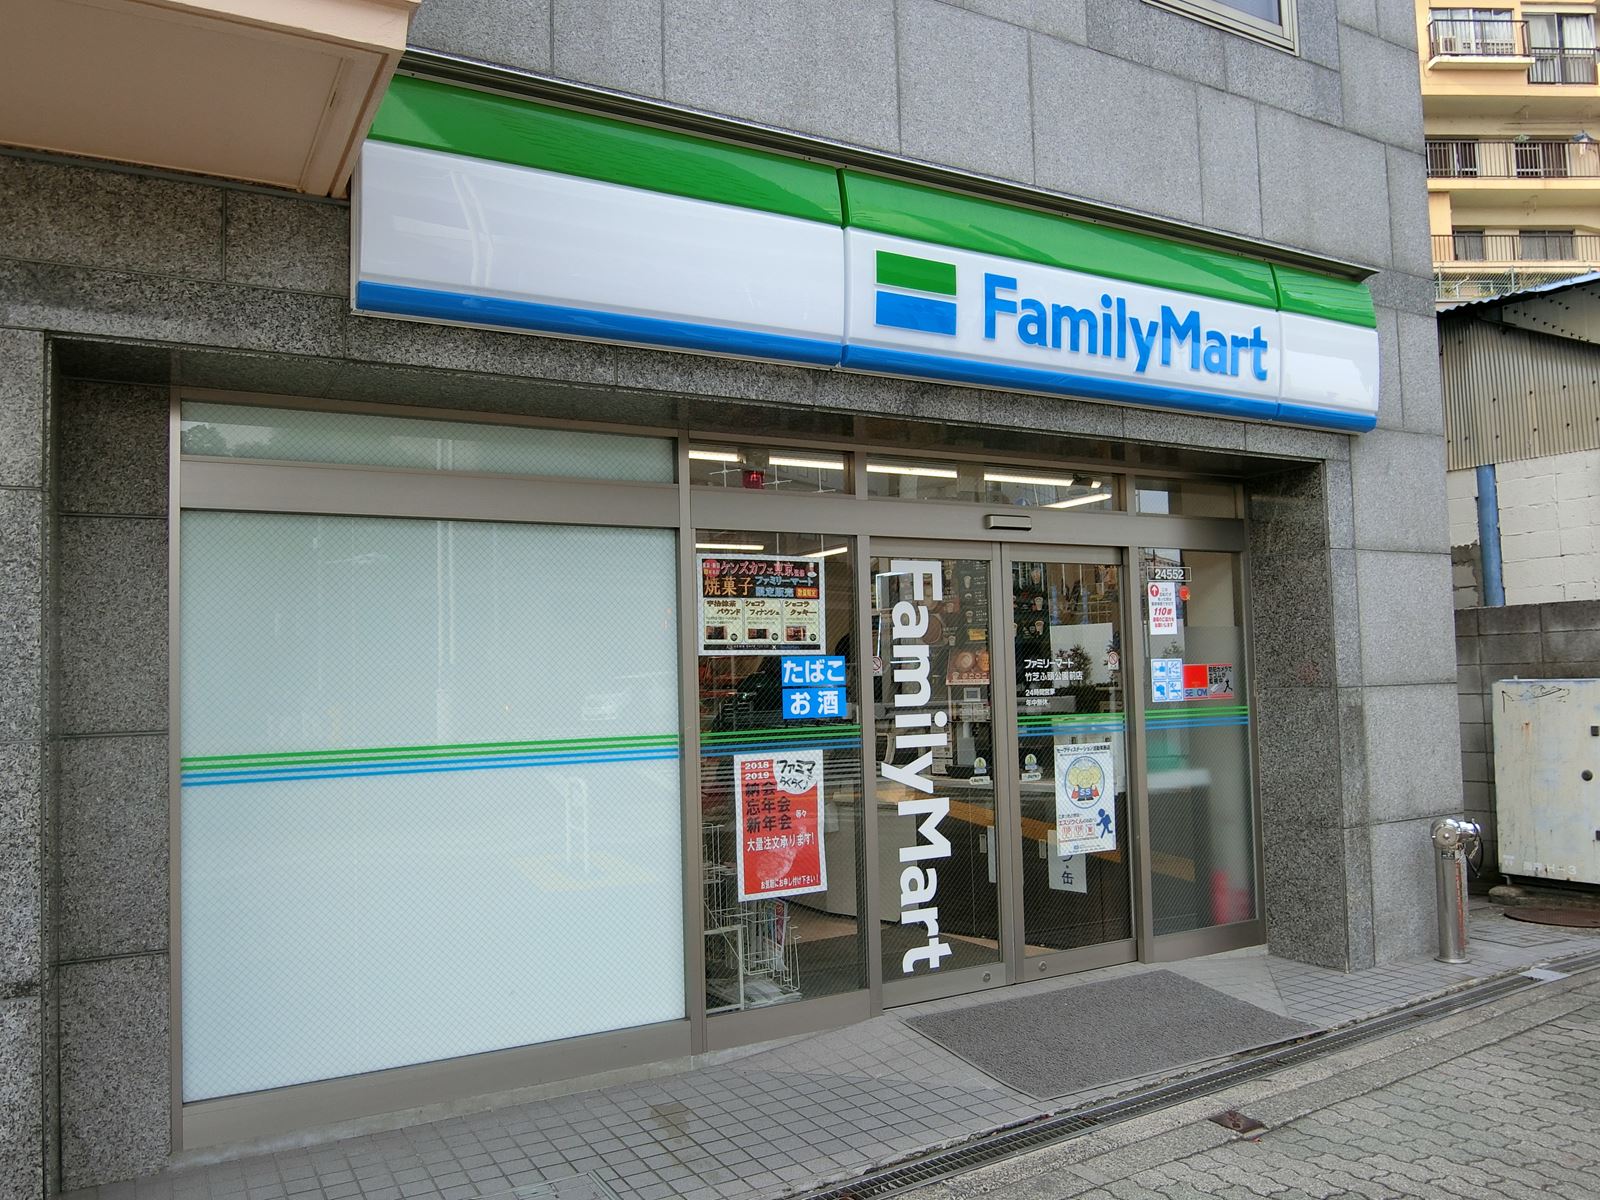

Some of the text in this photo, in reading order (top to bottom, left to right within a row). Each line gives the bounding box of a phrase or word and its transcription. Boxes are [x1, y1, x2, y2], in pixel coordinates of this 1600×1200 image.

[984, 272, 1268, 381] FamilyMart
[755, 575, 814, 587] ファミリーマート
[1154, 568, 1185, 580] 24552
[704, 576, 754, 596] 焼菓子
[783, 659, 845, 683] たばこ
[1023, 658, 1074, 668] ファミリーマート
[790, 690, 839, 715] お酒
[744, 761, 770, 770] 2018
[744, 771, 770, 780] 2019
[776, 759, 816, 775] ファミマ
[881, 560, 952, 973] FamilyMart
[746, 796, 791, 816] 忘年会
[746, 814, 793, 834] 新年会
